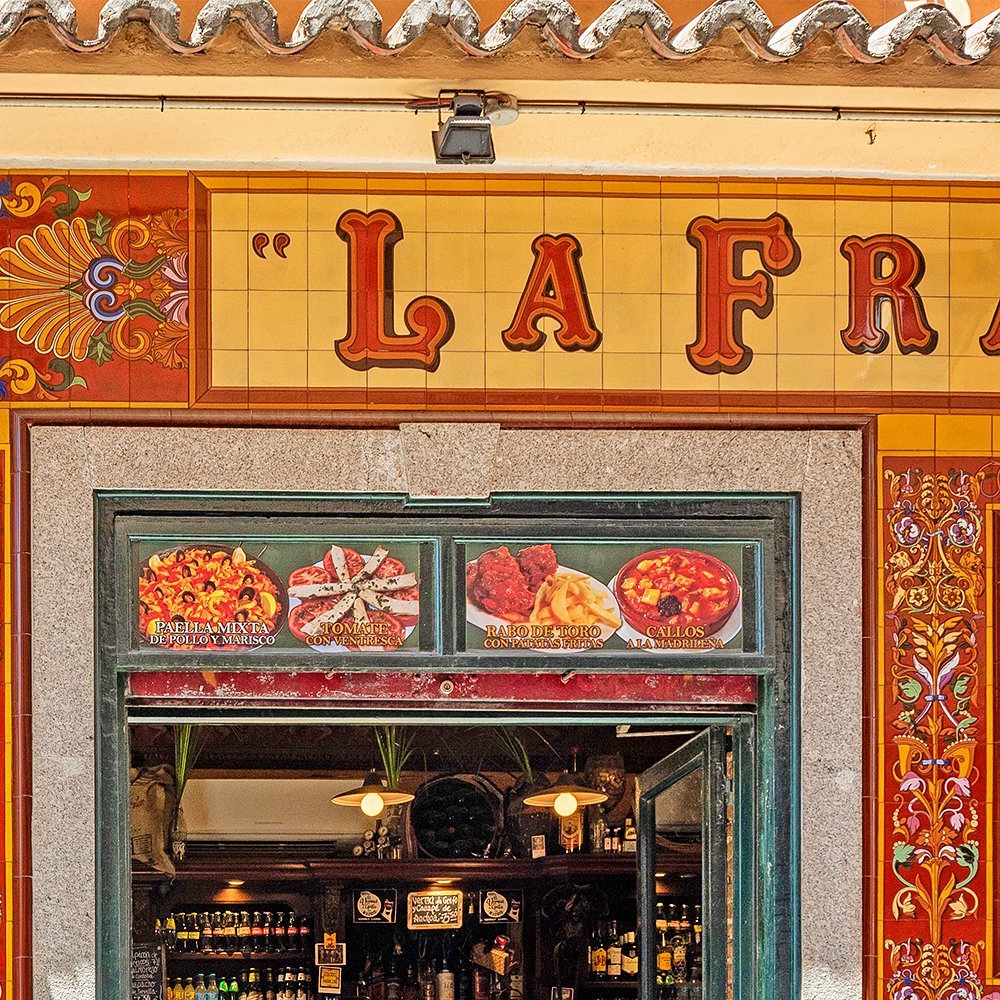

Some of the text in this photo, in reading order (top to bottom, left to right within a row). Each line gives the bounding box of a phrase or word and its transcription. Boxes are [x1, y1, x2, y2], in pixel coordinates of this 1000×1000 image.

[686, 211, 1000, 375] FR
[155, 621, 270, 634] PAELLA MIXTA
[320, 622, 388, 635] TOMATE
[486, 625, 602, 638] RABO DE TORO
[646, 625, 705, 638] CALLOS
[150, 635, 275, 645] DE POLLO Y MARISCO
[305, 635, 404, 646] CON VENTRESCA
[483, 638, 604, 649] CON PATATAS FRITAS
[626, 637, 725, 649] A LA MADRILEÑA
